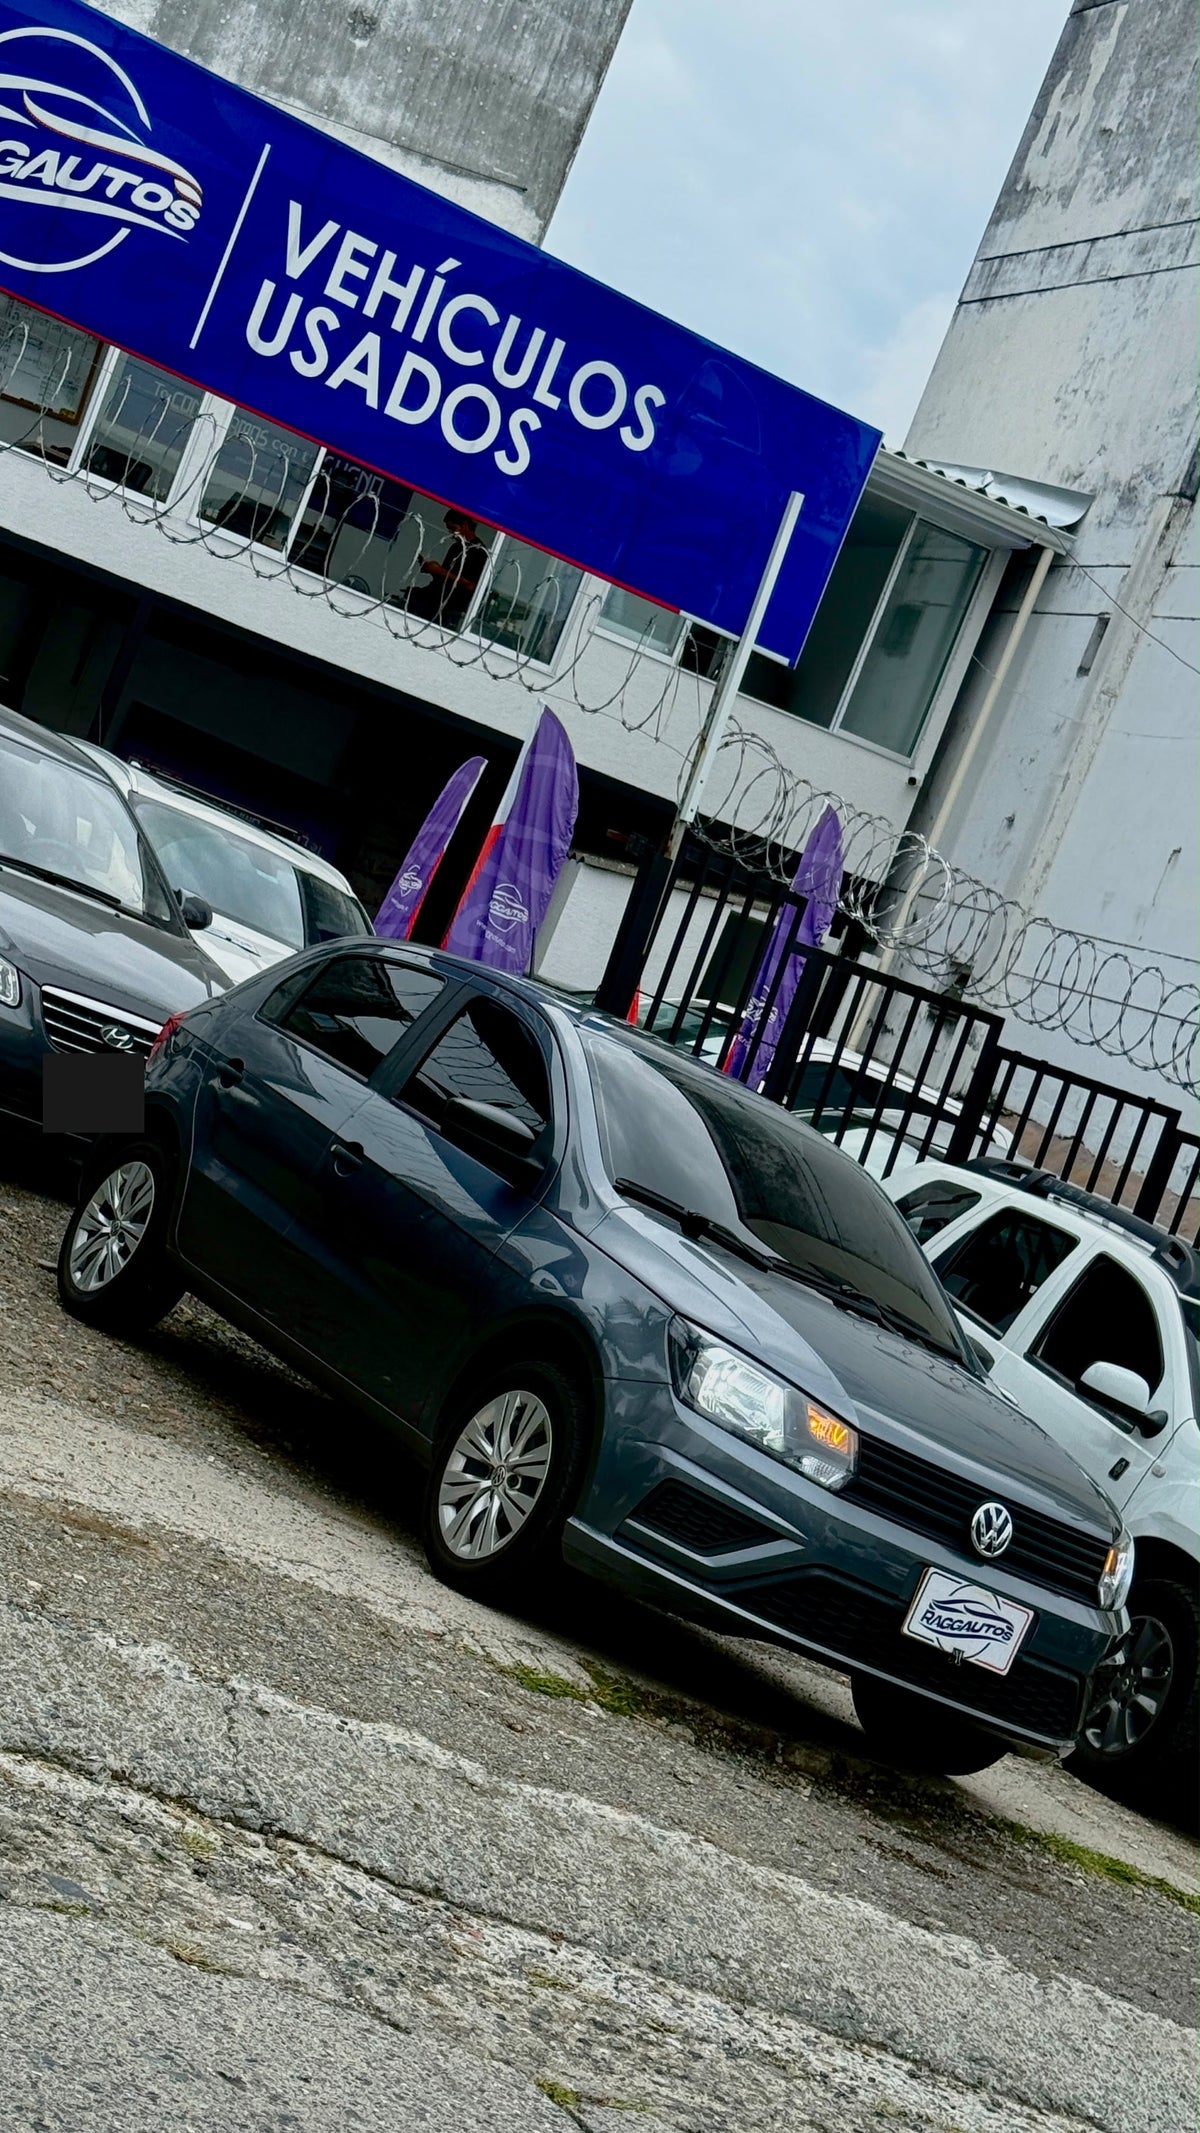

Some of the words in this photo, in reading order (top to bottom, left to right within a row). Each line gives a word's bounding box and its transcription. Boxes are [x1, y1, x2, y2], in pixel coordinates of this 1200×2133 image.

[246, 278, 542, 475] USADOS
[286, 200, 666, 451] VEHÍCULOS
[920, 1609, 1013, 1641] RAGGAUTOS
